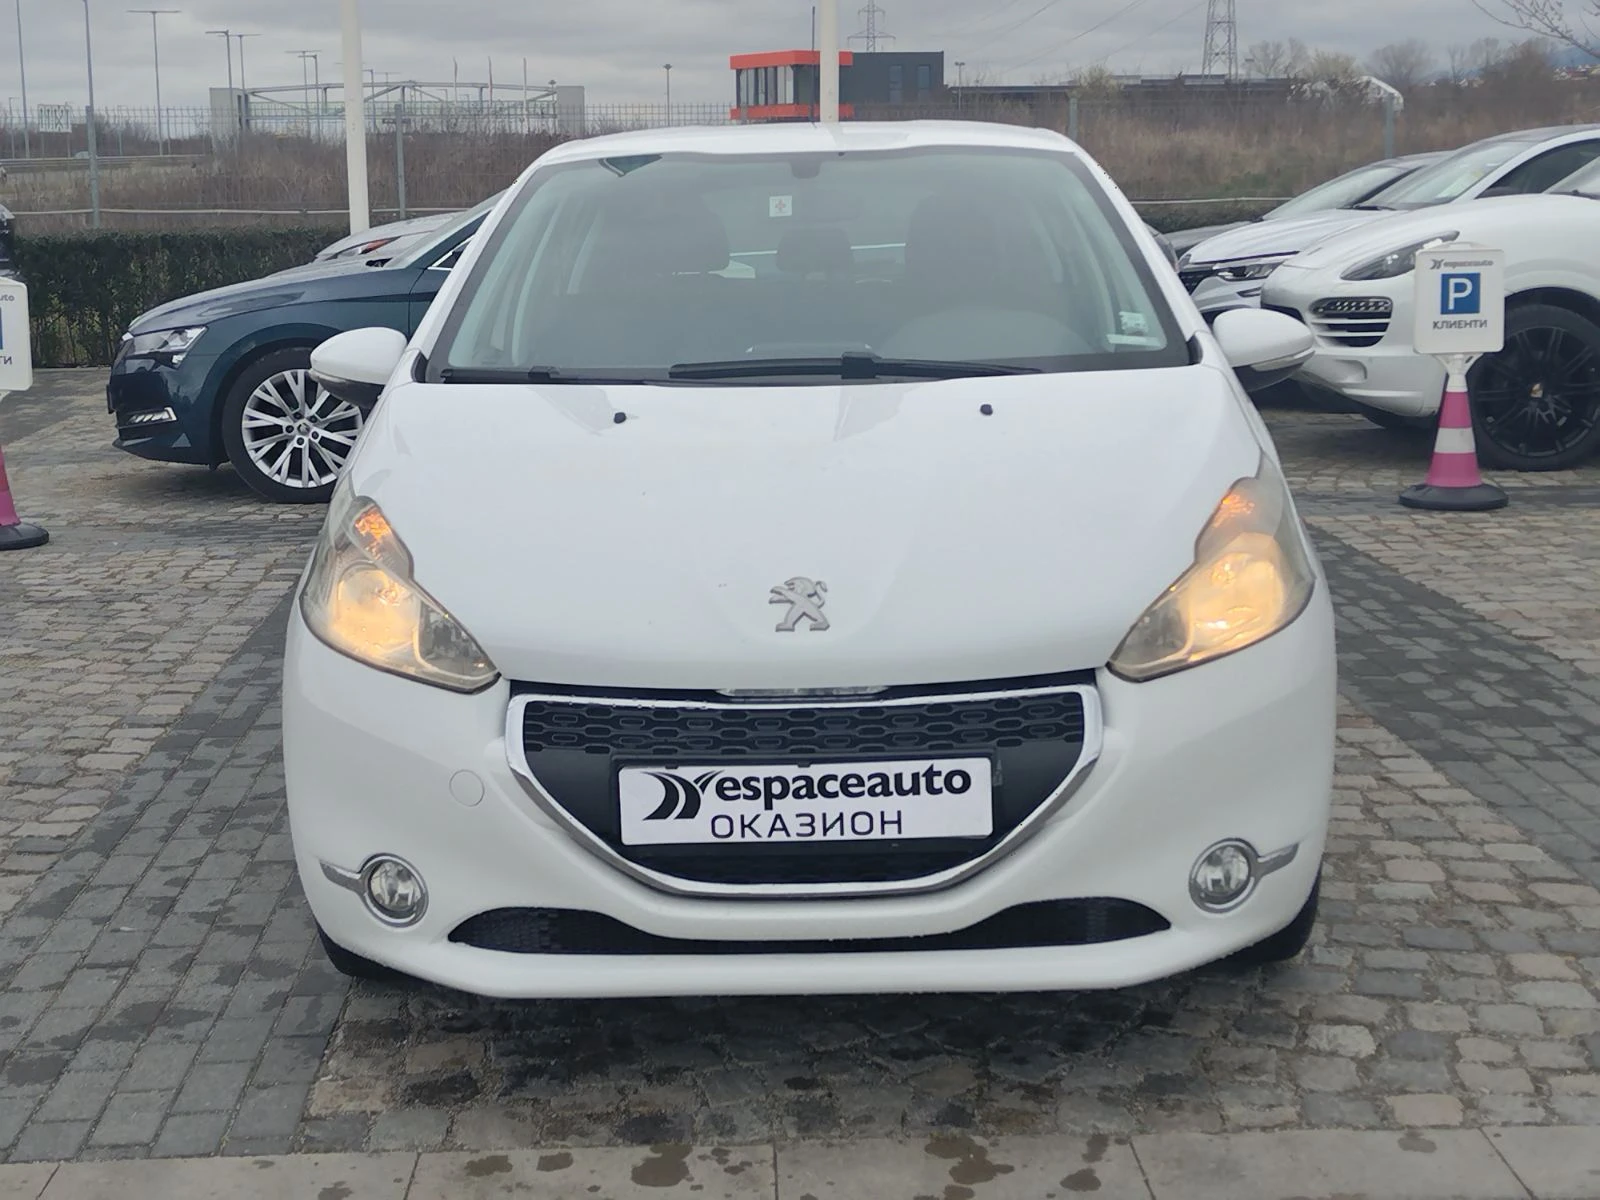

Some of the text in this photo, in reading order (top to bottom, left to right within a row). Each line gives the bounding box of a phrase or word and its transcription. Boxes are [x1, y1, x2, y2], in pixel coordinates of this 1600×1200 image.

[1448, 278, 1473, 310] P
[1432, 319, 1488, 330] КЛИЕНТИ
[714, 763, 972, 810] espaceauto
[710, 810, 903, 839] ОКАЗИОН
